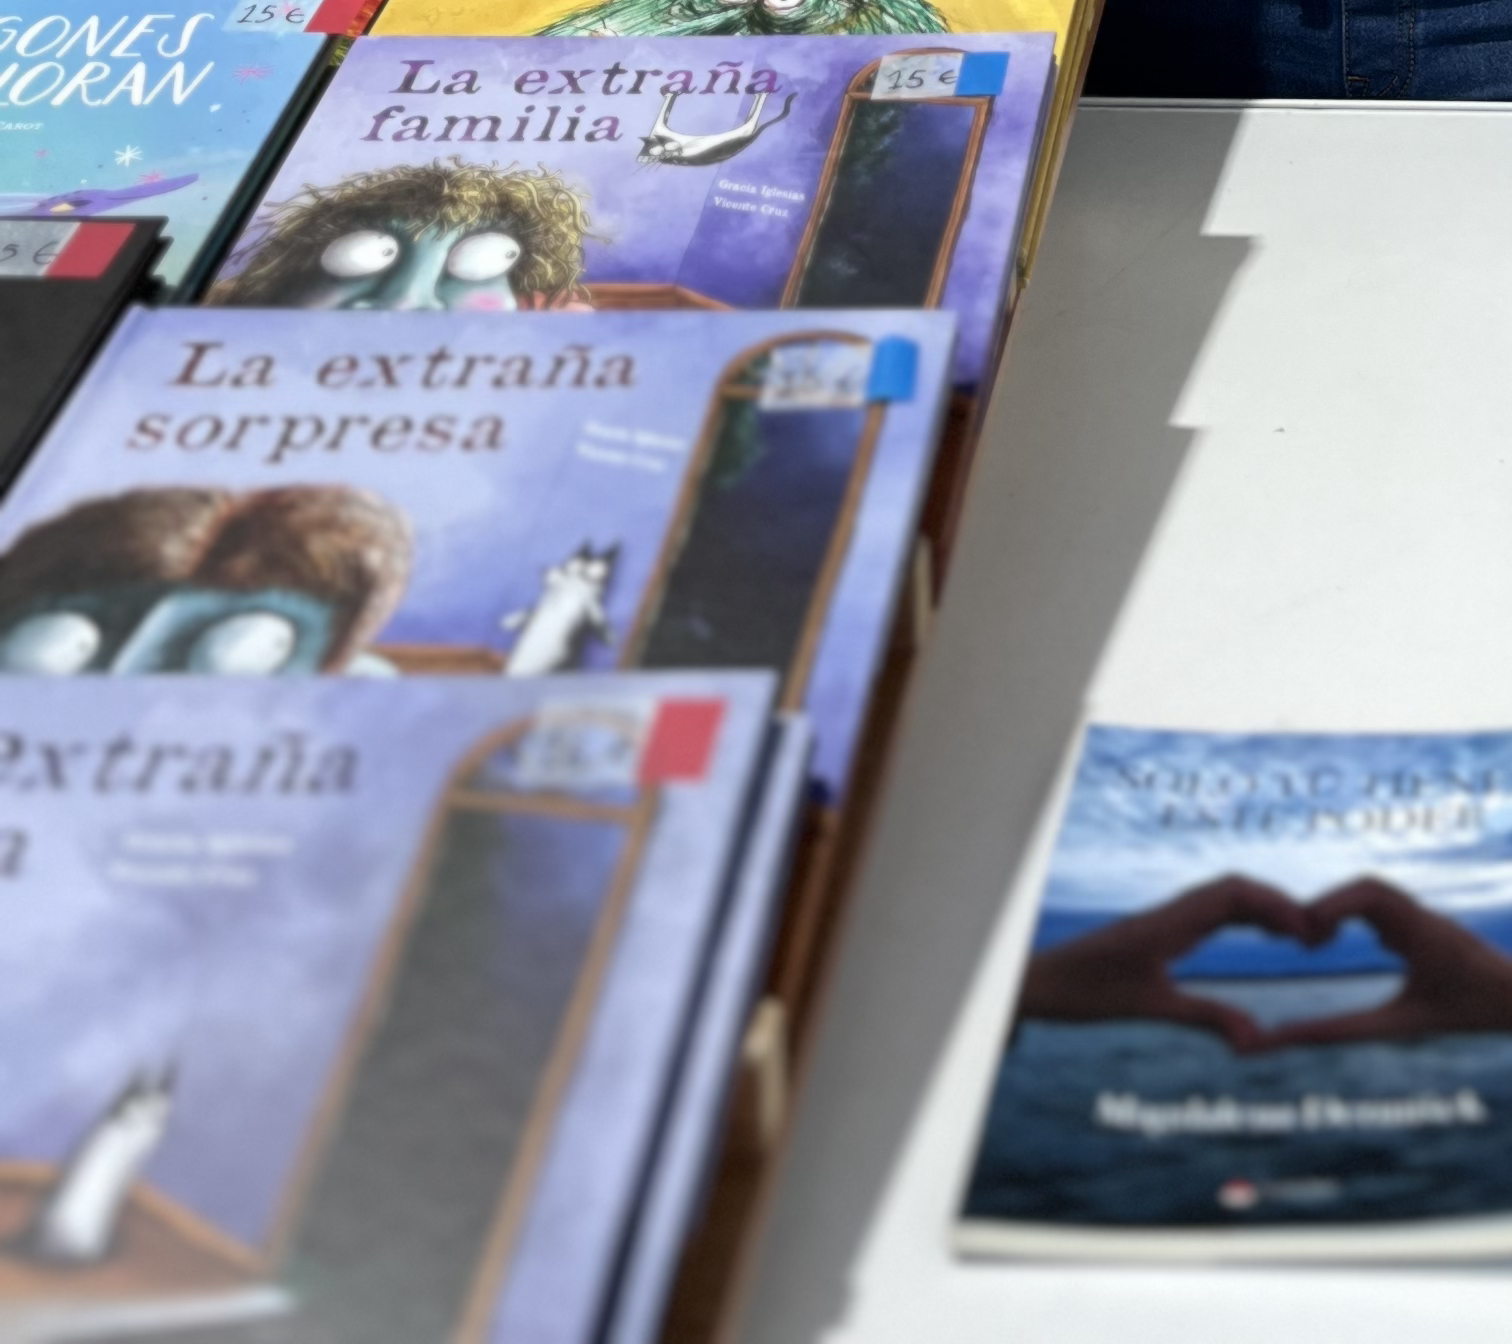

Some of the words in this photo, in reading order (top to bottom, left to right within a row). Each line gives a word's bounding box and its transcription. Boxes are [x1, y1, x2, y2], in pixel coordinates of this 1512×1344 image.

[237, 4, 278, 24] 15
[388, 59, 482, 96] La
[513, 60, 783, 97] extraña
[887, 69, 926, 89] 15
[938, 69, 958, 85] €
[359, 103, 624, 143] familia
[718, 178, 759, 194] Gracia
[761, 183, 806, 201] Iglesias
[713, 195, 758, 212] Vicente
[760, 203, 789, 218] Cruz
[166, 340, 276, 391] La
[315, 342, 639, 391] extraña
[126, 407, 508, 465] sorpresa
